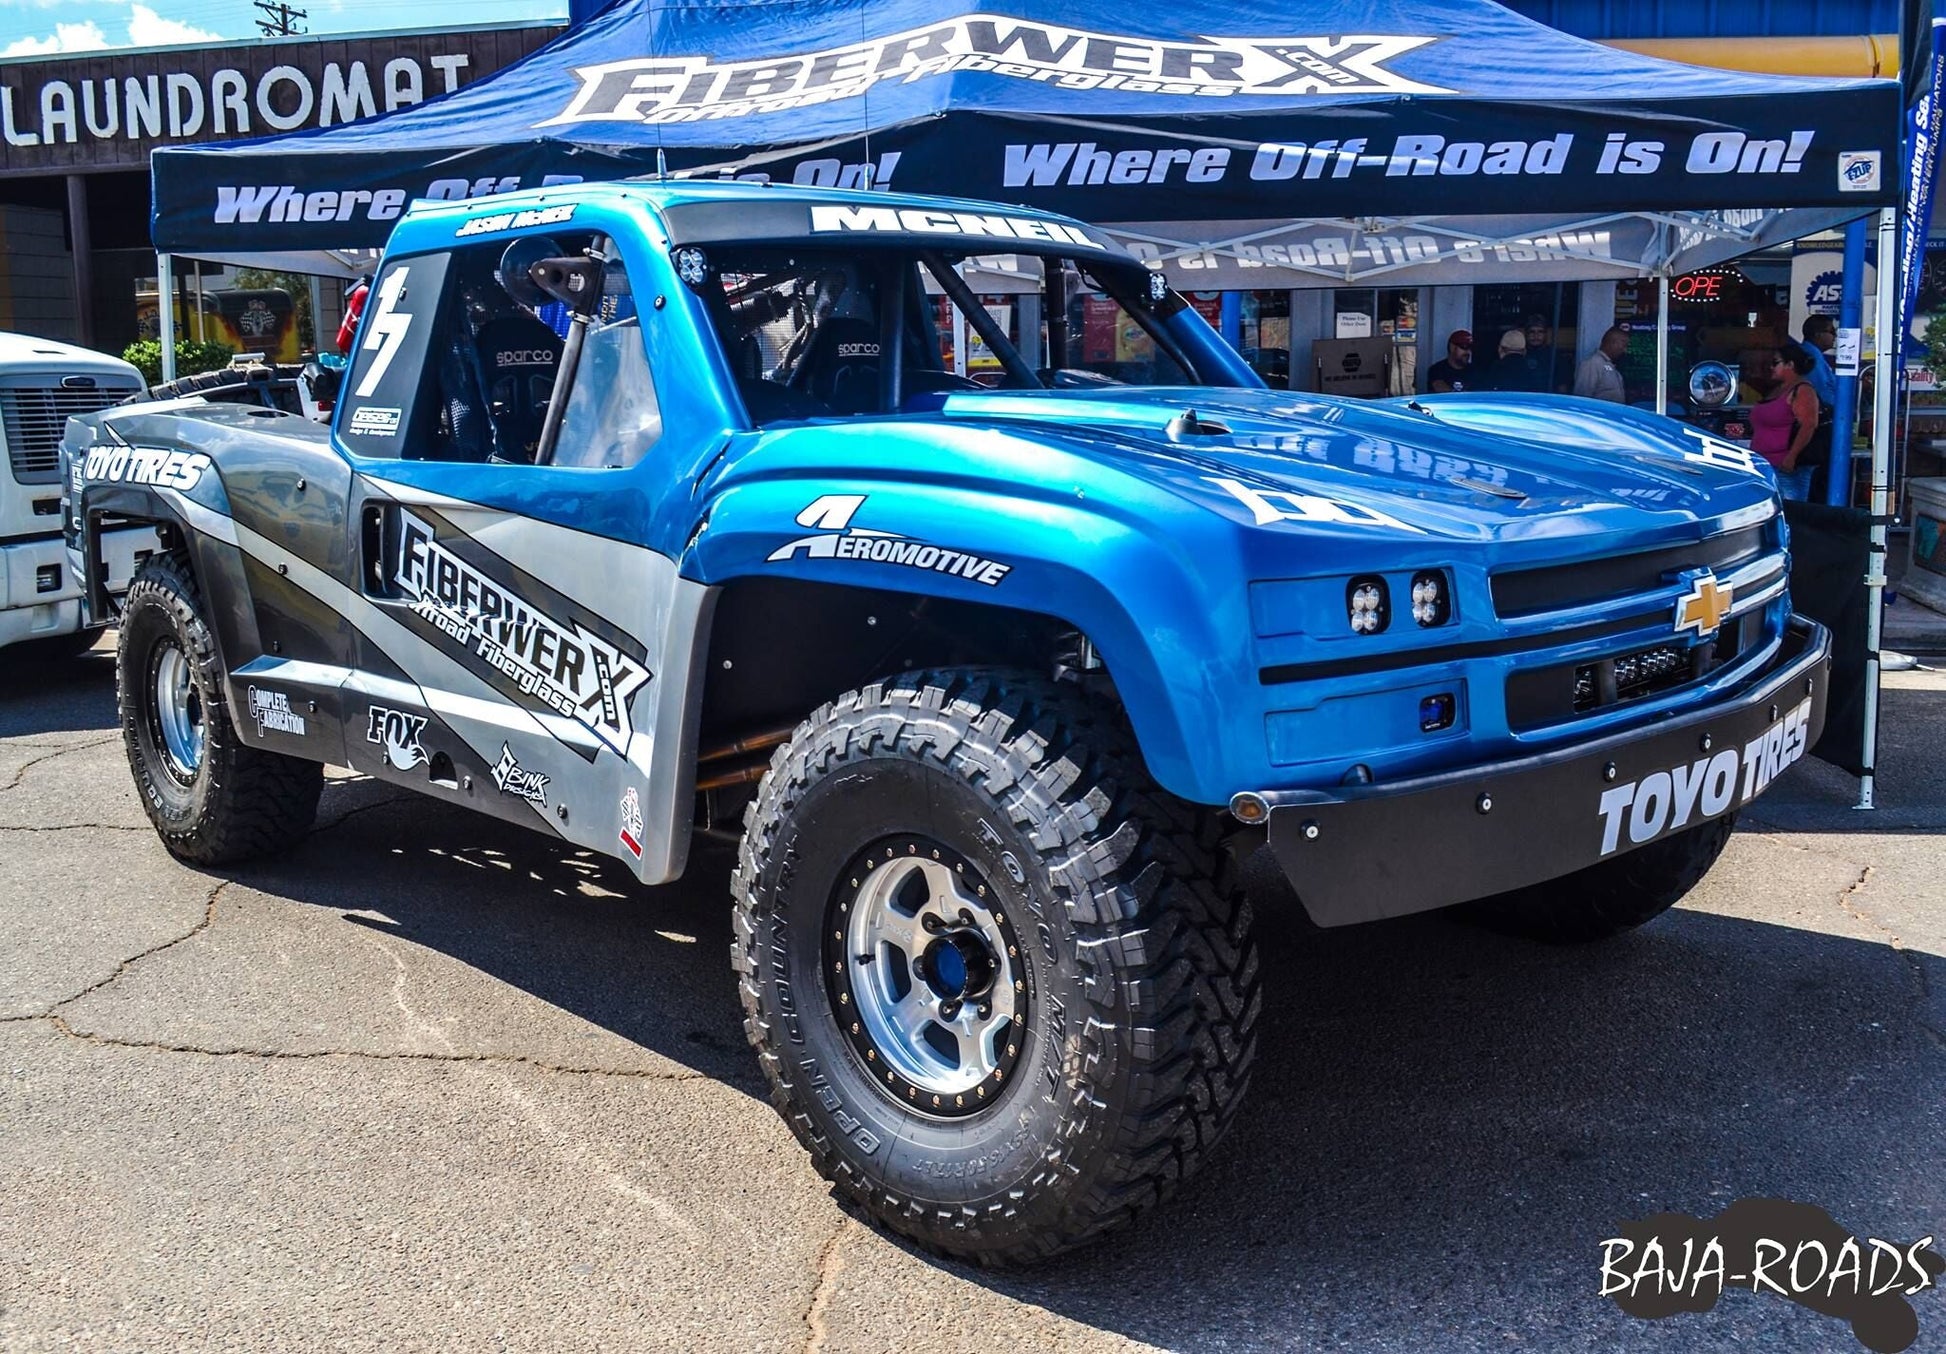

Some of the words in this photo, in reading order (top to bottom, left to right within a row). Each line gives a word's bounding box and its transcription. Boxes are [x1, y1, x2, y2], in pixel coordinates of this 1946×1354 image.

[560, 15, 1445, 123] FIBERWERX
[902, 53, 1241, 98] Fiberglass
[1277, 46, 1353, 85] .com
[1, 54, 469, 147] LAUNDROMAT
[1003, 143, 1231, 187] Where
[1250, 133, 1574, 181] Off-Road
[1595, 131, 1667, 175] is
[1685, 131, 1817, 175] On!
[214, 186, 407, 223] Where
[810, 206, 1106, 249] MCNEIL
[1813, 284, 1843, 302] AS
[355, 266, 413, 397] 17
[496, 350, 553, 364] sparco
[838, 343, 880, 355] sparco
[126, 448, 211, 491] TIRES
[767, 494, 1010, 586] AEROMOTIVE
[399, 515, 643, 742] FIBERWERX
[476, 636, 577, 718] Fiberglass
[596, 654, 617, 721] .com
[366, 705, 429, 751] FOX
[1598, 749, 1739, 856] TOYO
[1741, 697, 1812, 801] TIRES
